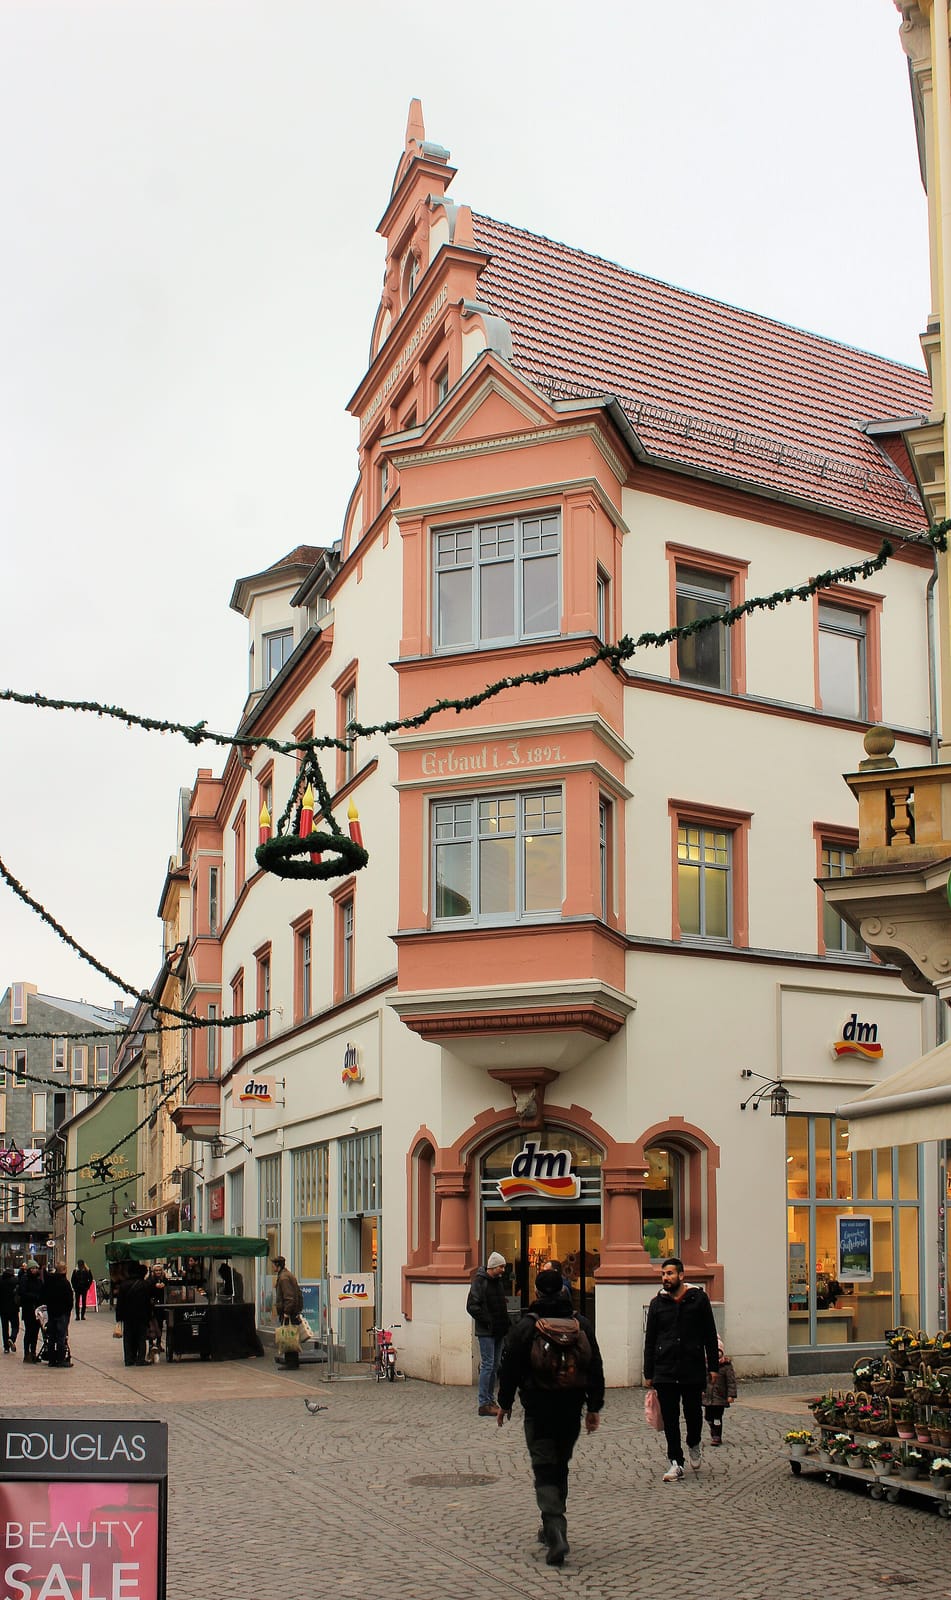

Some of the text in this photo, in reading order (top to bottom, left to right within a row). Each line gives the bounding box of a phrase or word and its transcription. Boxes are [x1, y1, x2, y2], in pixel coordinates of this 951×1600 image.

[842, 1013, 878, 1042] dm
[344, 1042, 357, 1069] dm
[244, 1079, 268, 1095] dm
[512, 1142, 567, 1178] dm
[342, 1279, 365, 1294] dm
[5, 1432, 147, 1462] DOUGLAS
[5, 1520, 144, 1549] BEAUTY
[4, 1562, 140, 1600] SALE
